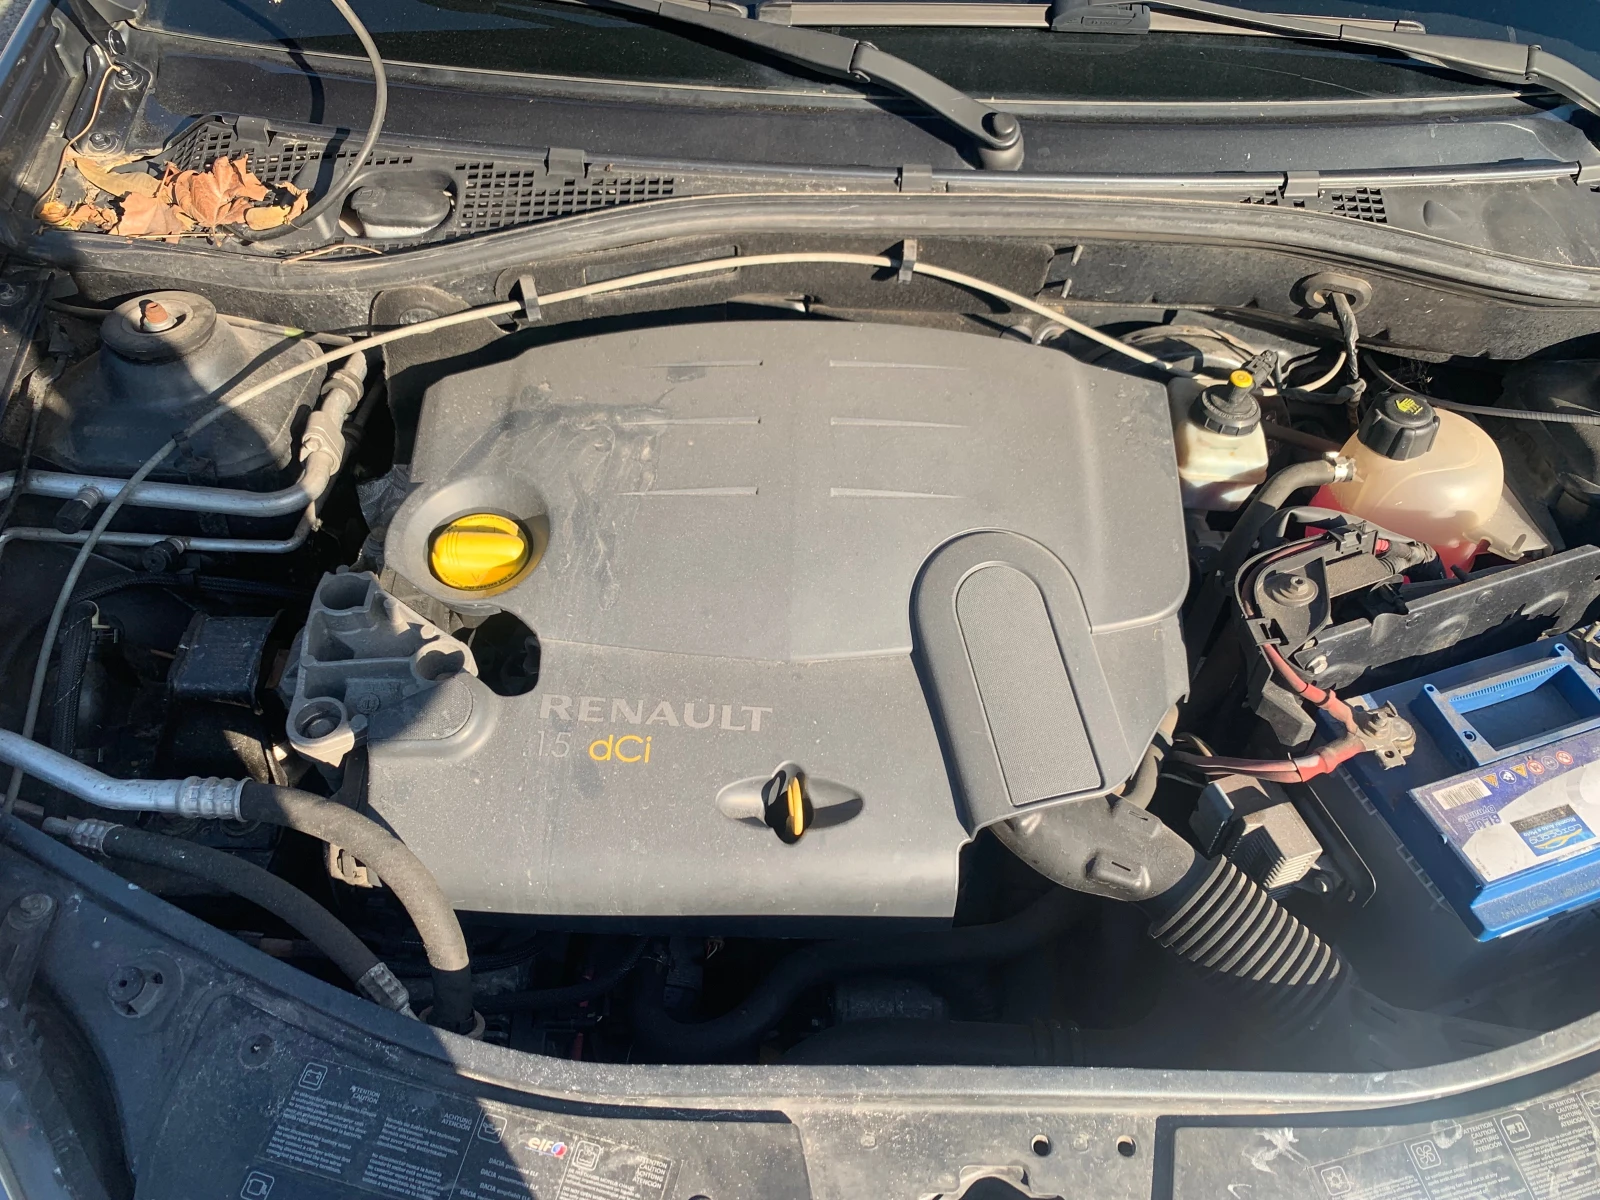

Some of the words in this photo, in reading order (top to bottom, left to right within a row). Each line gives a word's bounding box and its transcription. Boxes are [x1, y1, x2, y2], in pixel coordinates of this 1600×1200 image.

[540, 694, 773, 732] RENAULT
[538, 730, 571, 758] 1.5
[588, 734, 652, 763] dCi
[1464, 813, 1502, 833] BLUE
[352, 1092, 378, 1104] CAUTION
[1548, 1097, 1575, 1109] ATTENTION
[1556, 1103, 1578, 1114] CAUTION
[444, 1112, 473, 1125] ACHTUNG
[1558, 1110, 1581, 1121] ACHTUNG
[1463, 1121, 1493, 1135] ATTENTION
[1471, 1128, 1496, 1140] CAUTION
[527, 1137, 552, 1152] elf
[1472, 1135, 1499, 1146] ACHTUNG
[488, 1157, 505, 1167] DACIA
[479, 1168, 497, 1178] DACIA
[639, 1163, 665, 1175] CAUTION
[636, 1170, 664, 1182] ACHTUNG
[460, 1188, 476, 1198] DACIA
[478, 1182, 496, 1192] DACIA
